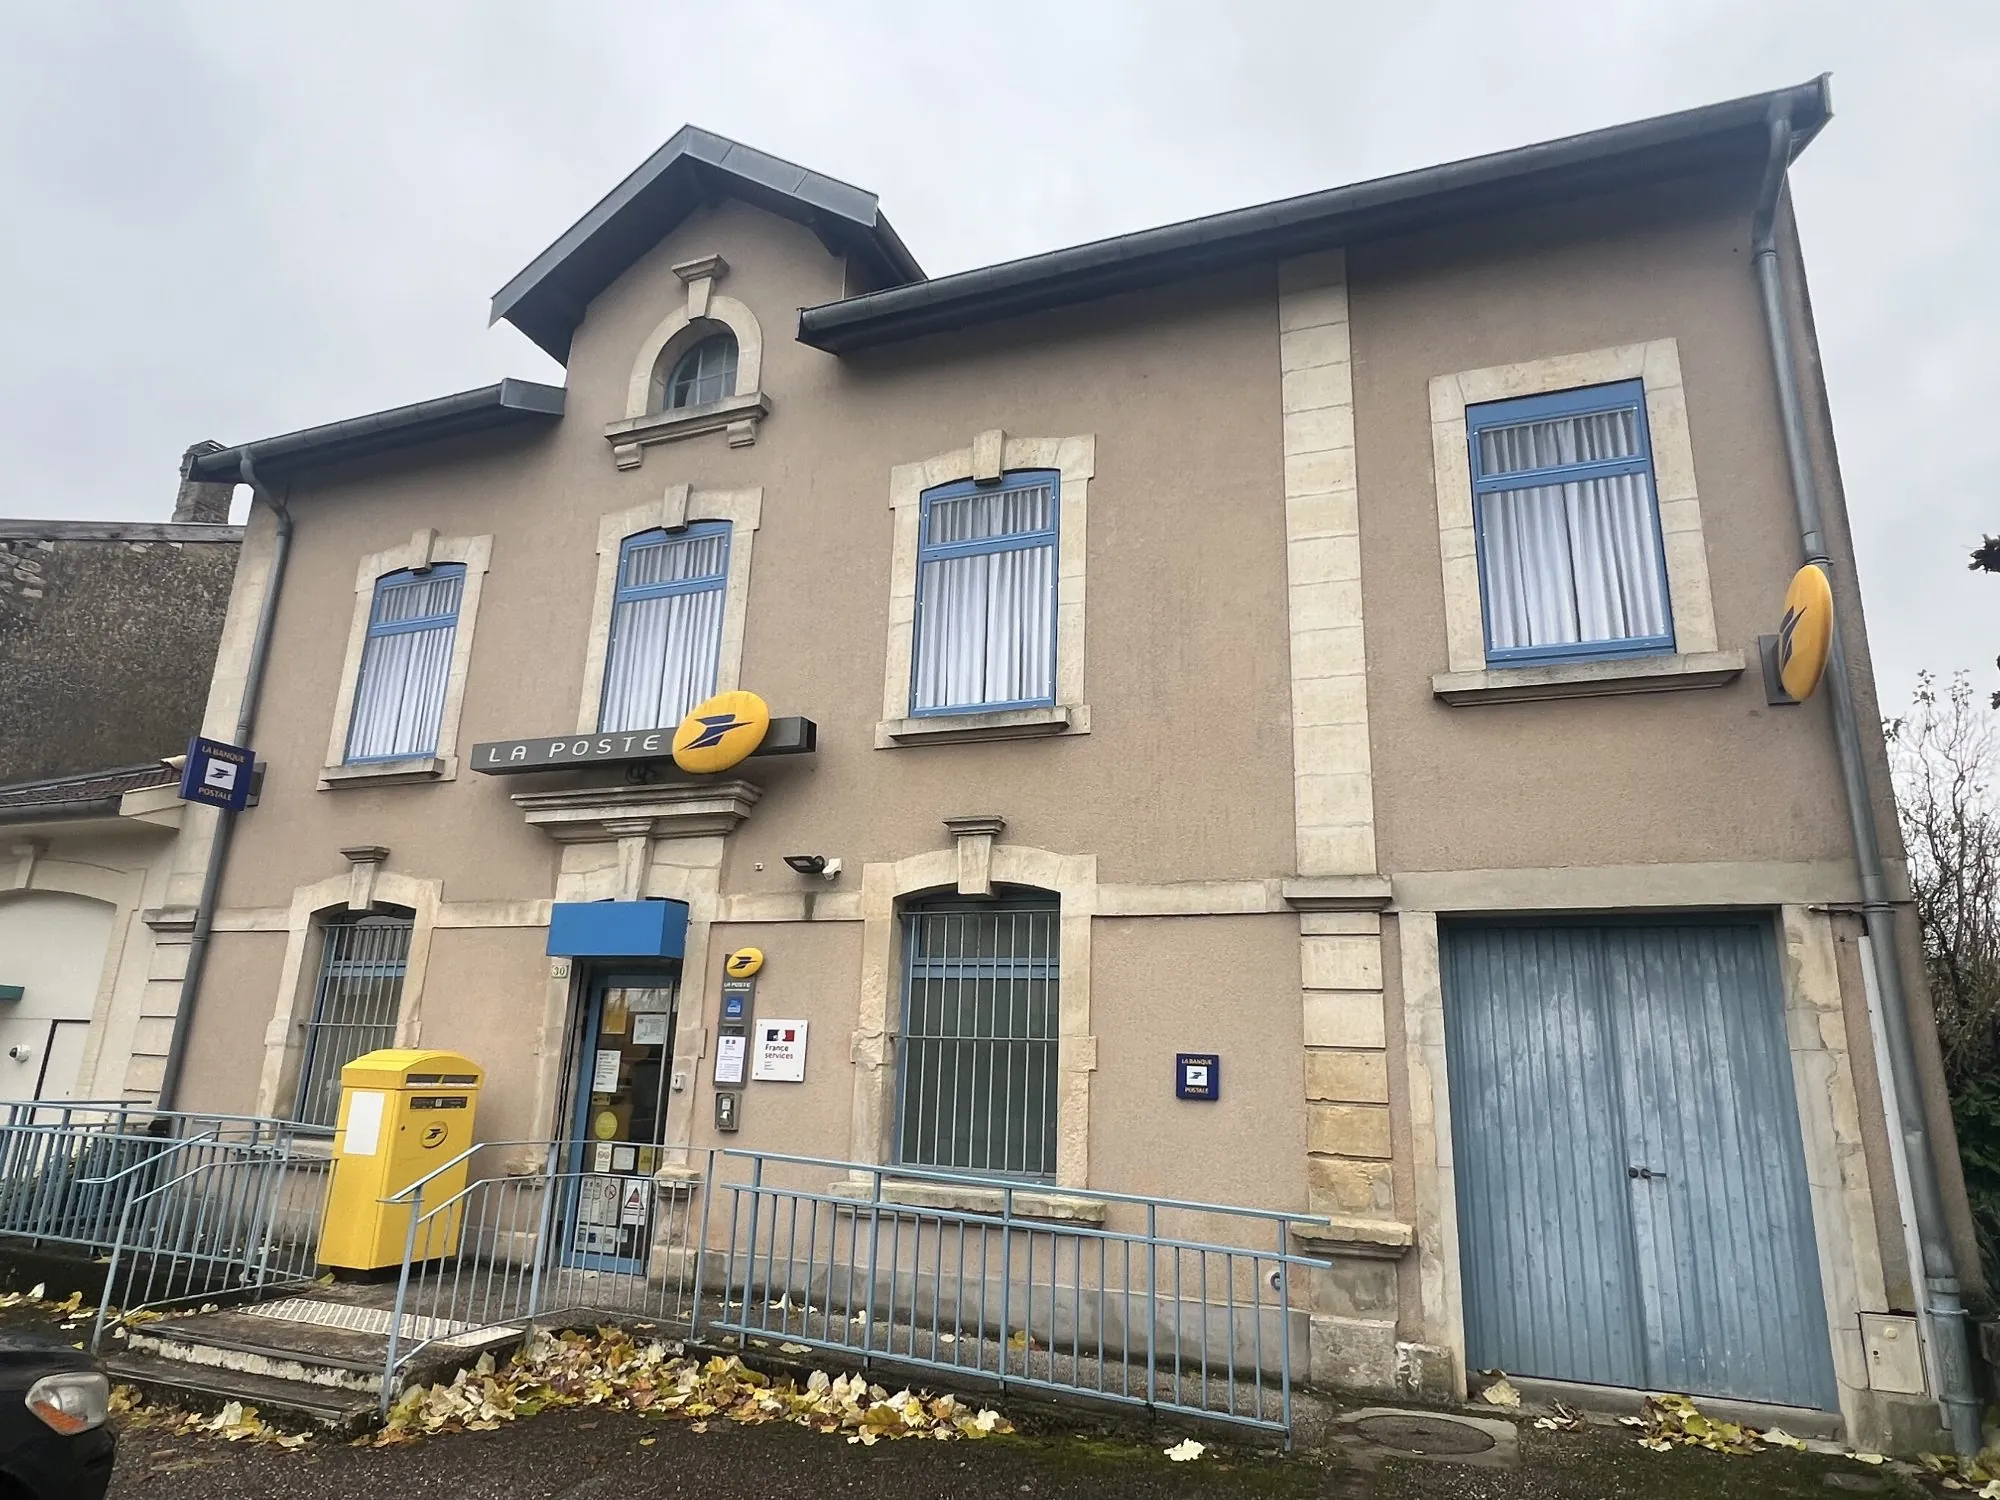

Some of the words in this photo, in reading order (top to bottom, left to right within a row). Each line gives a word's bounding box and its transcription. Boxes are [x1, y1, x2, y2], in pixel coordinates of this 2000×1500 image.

[201, 745, 212, 754] LA
[213, 748, 245, 763] BANQUE
[488, 745, 527, 763] LA
[548, 734, 661, 758] POSTE
[198, 786, 233, 801] POSTALE
[553, 966, 565, 976] 30
[764, 1044, 789, 1052] France
